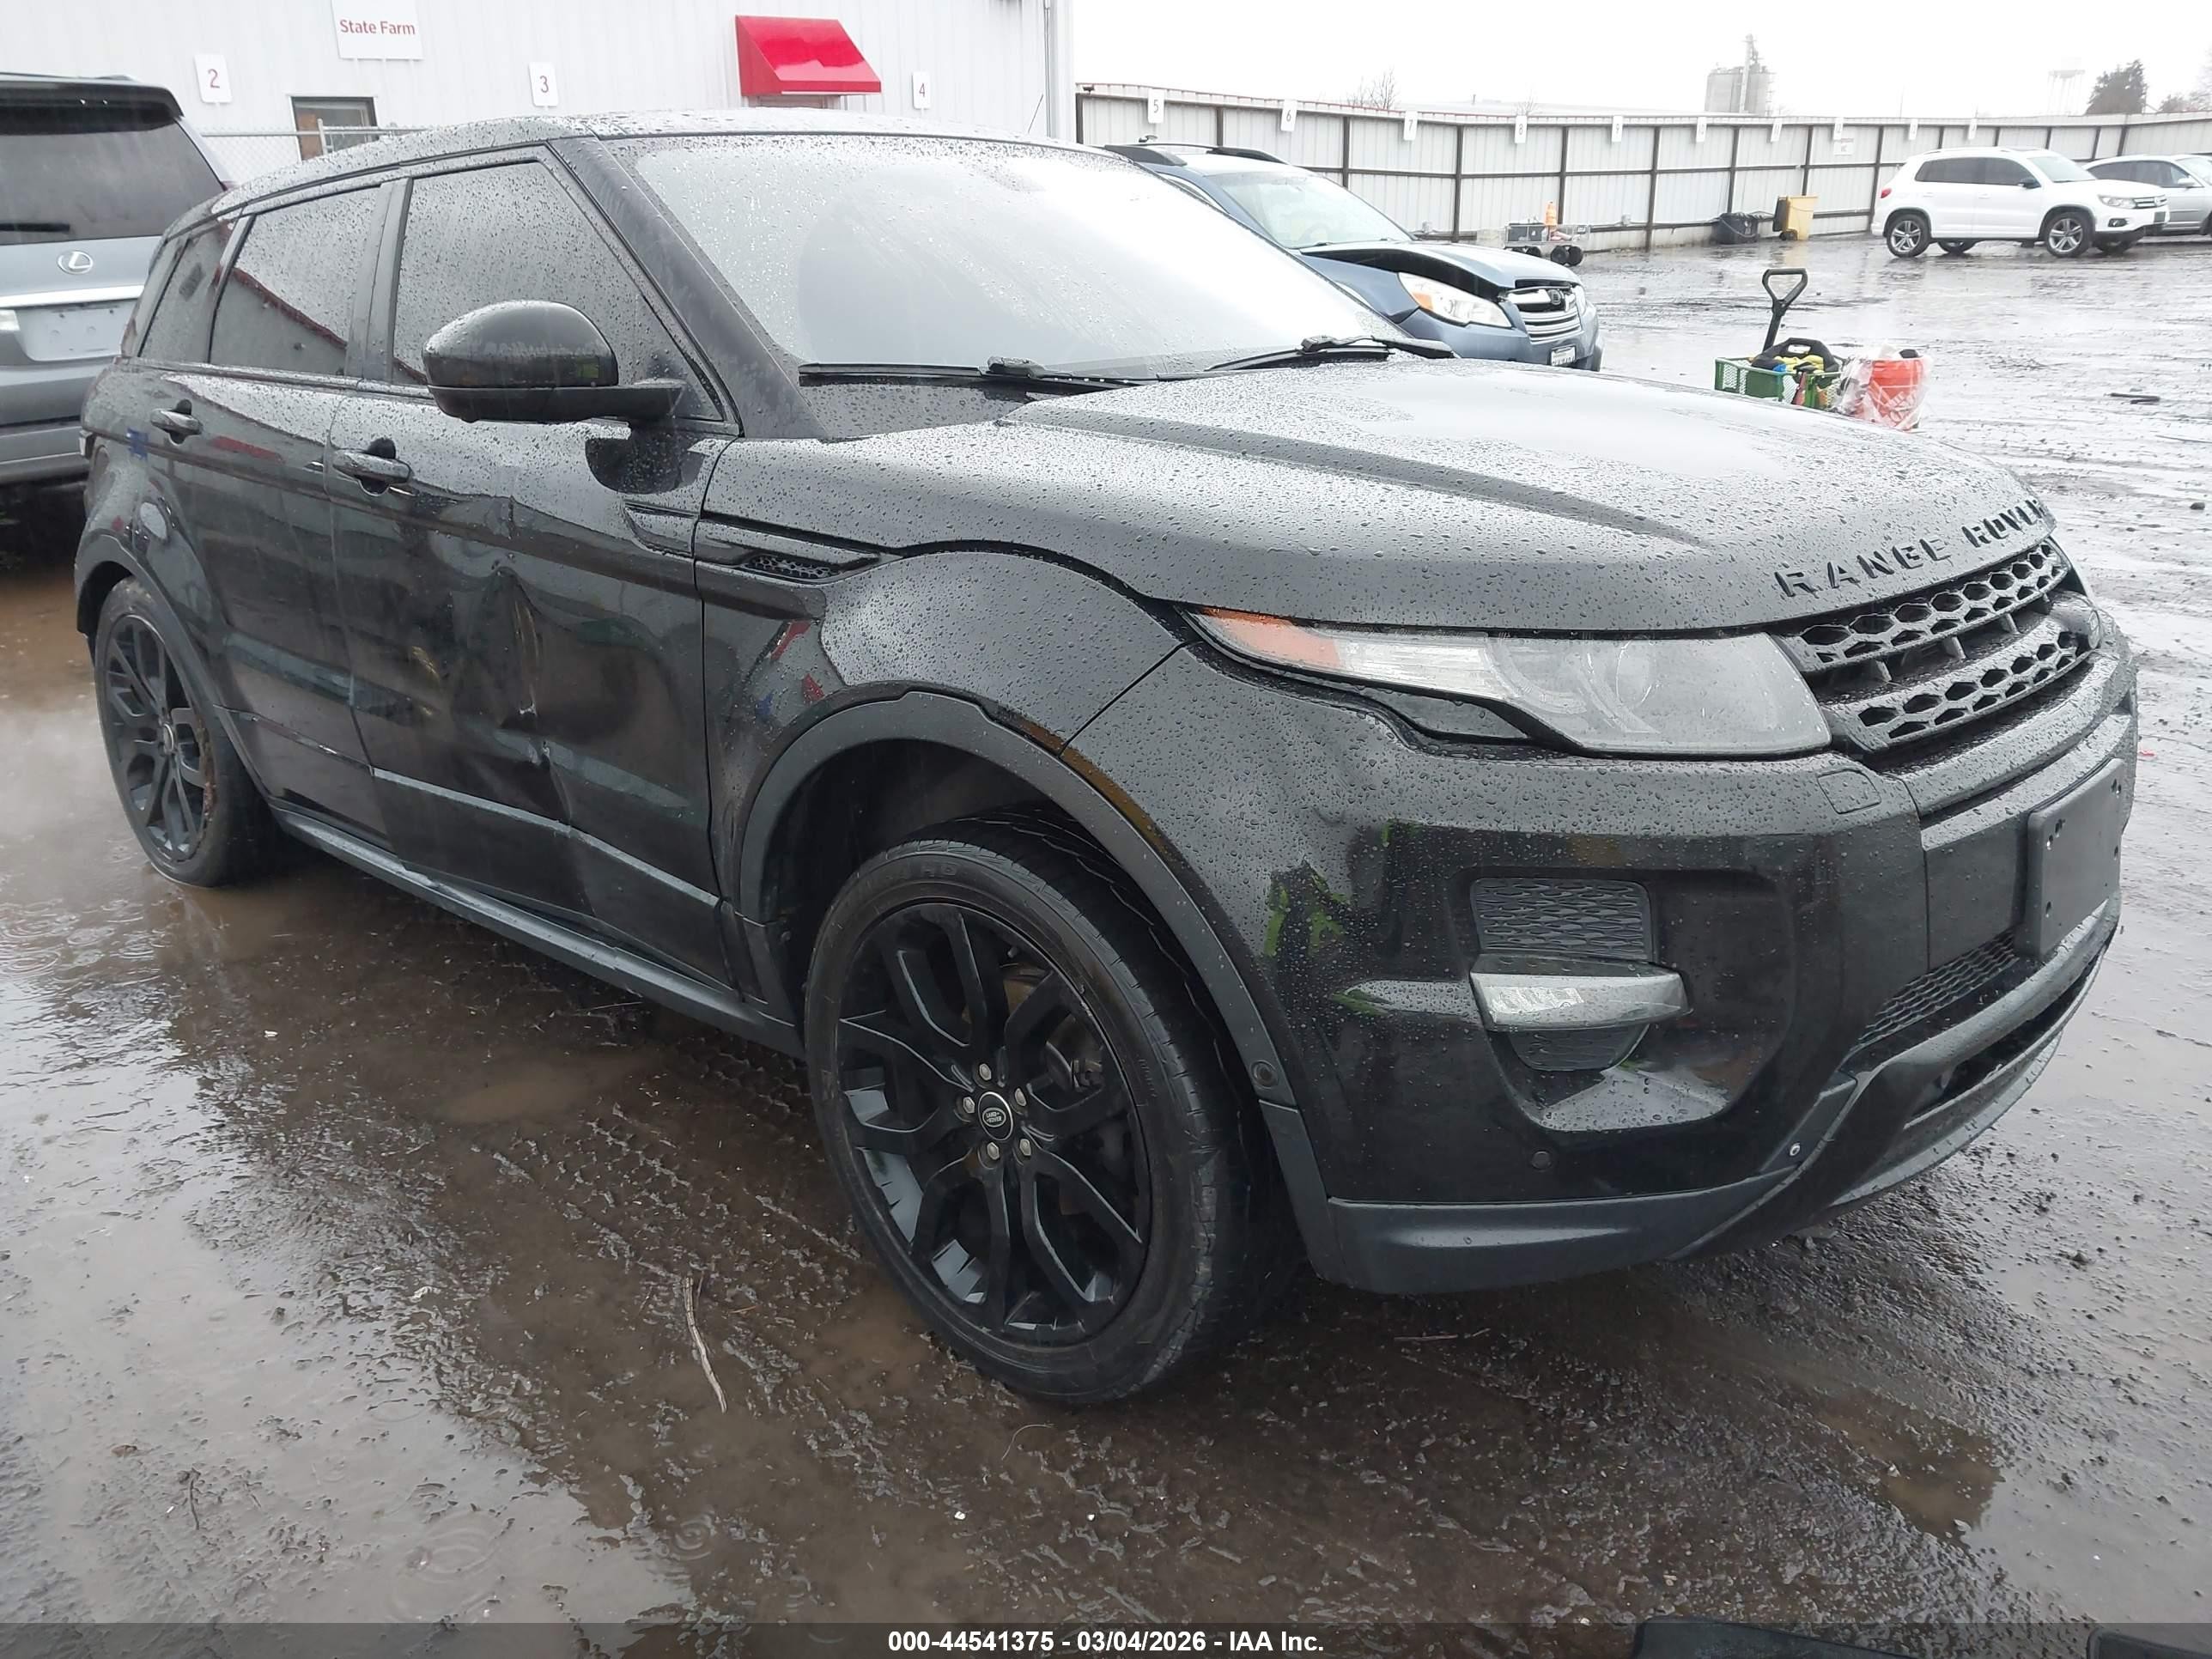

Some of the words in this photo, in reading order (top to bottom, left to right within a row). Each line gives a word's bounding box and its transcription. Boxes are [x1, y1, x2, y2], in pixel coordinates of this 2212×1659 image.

[339, 18, 377, 34] State
[380, 20, 416, 35] Farm
[208, 68, 221, 88] 2
[539, 75, 550, 94] 3
[919, 82, 926, 97] 4
[1153, 99, 1159, 113] 5
[1285, 109, 1291, 122] 6
[1408, 118, 1413, 131] 7
[1518, 123, 1523, 136] 8
[1774, 538, 1952, 599] RANGE
